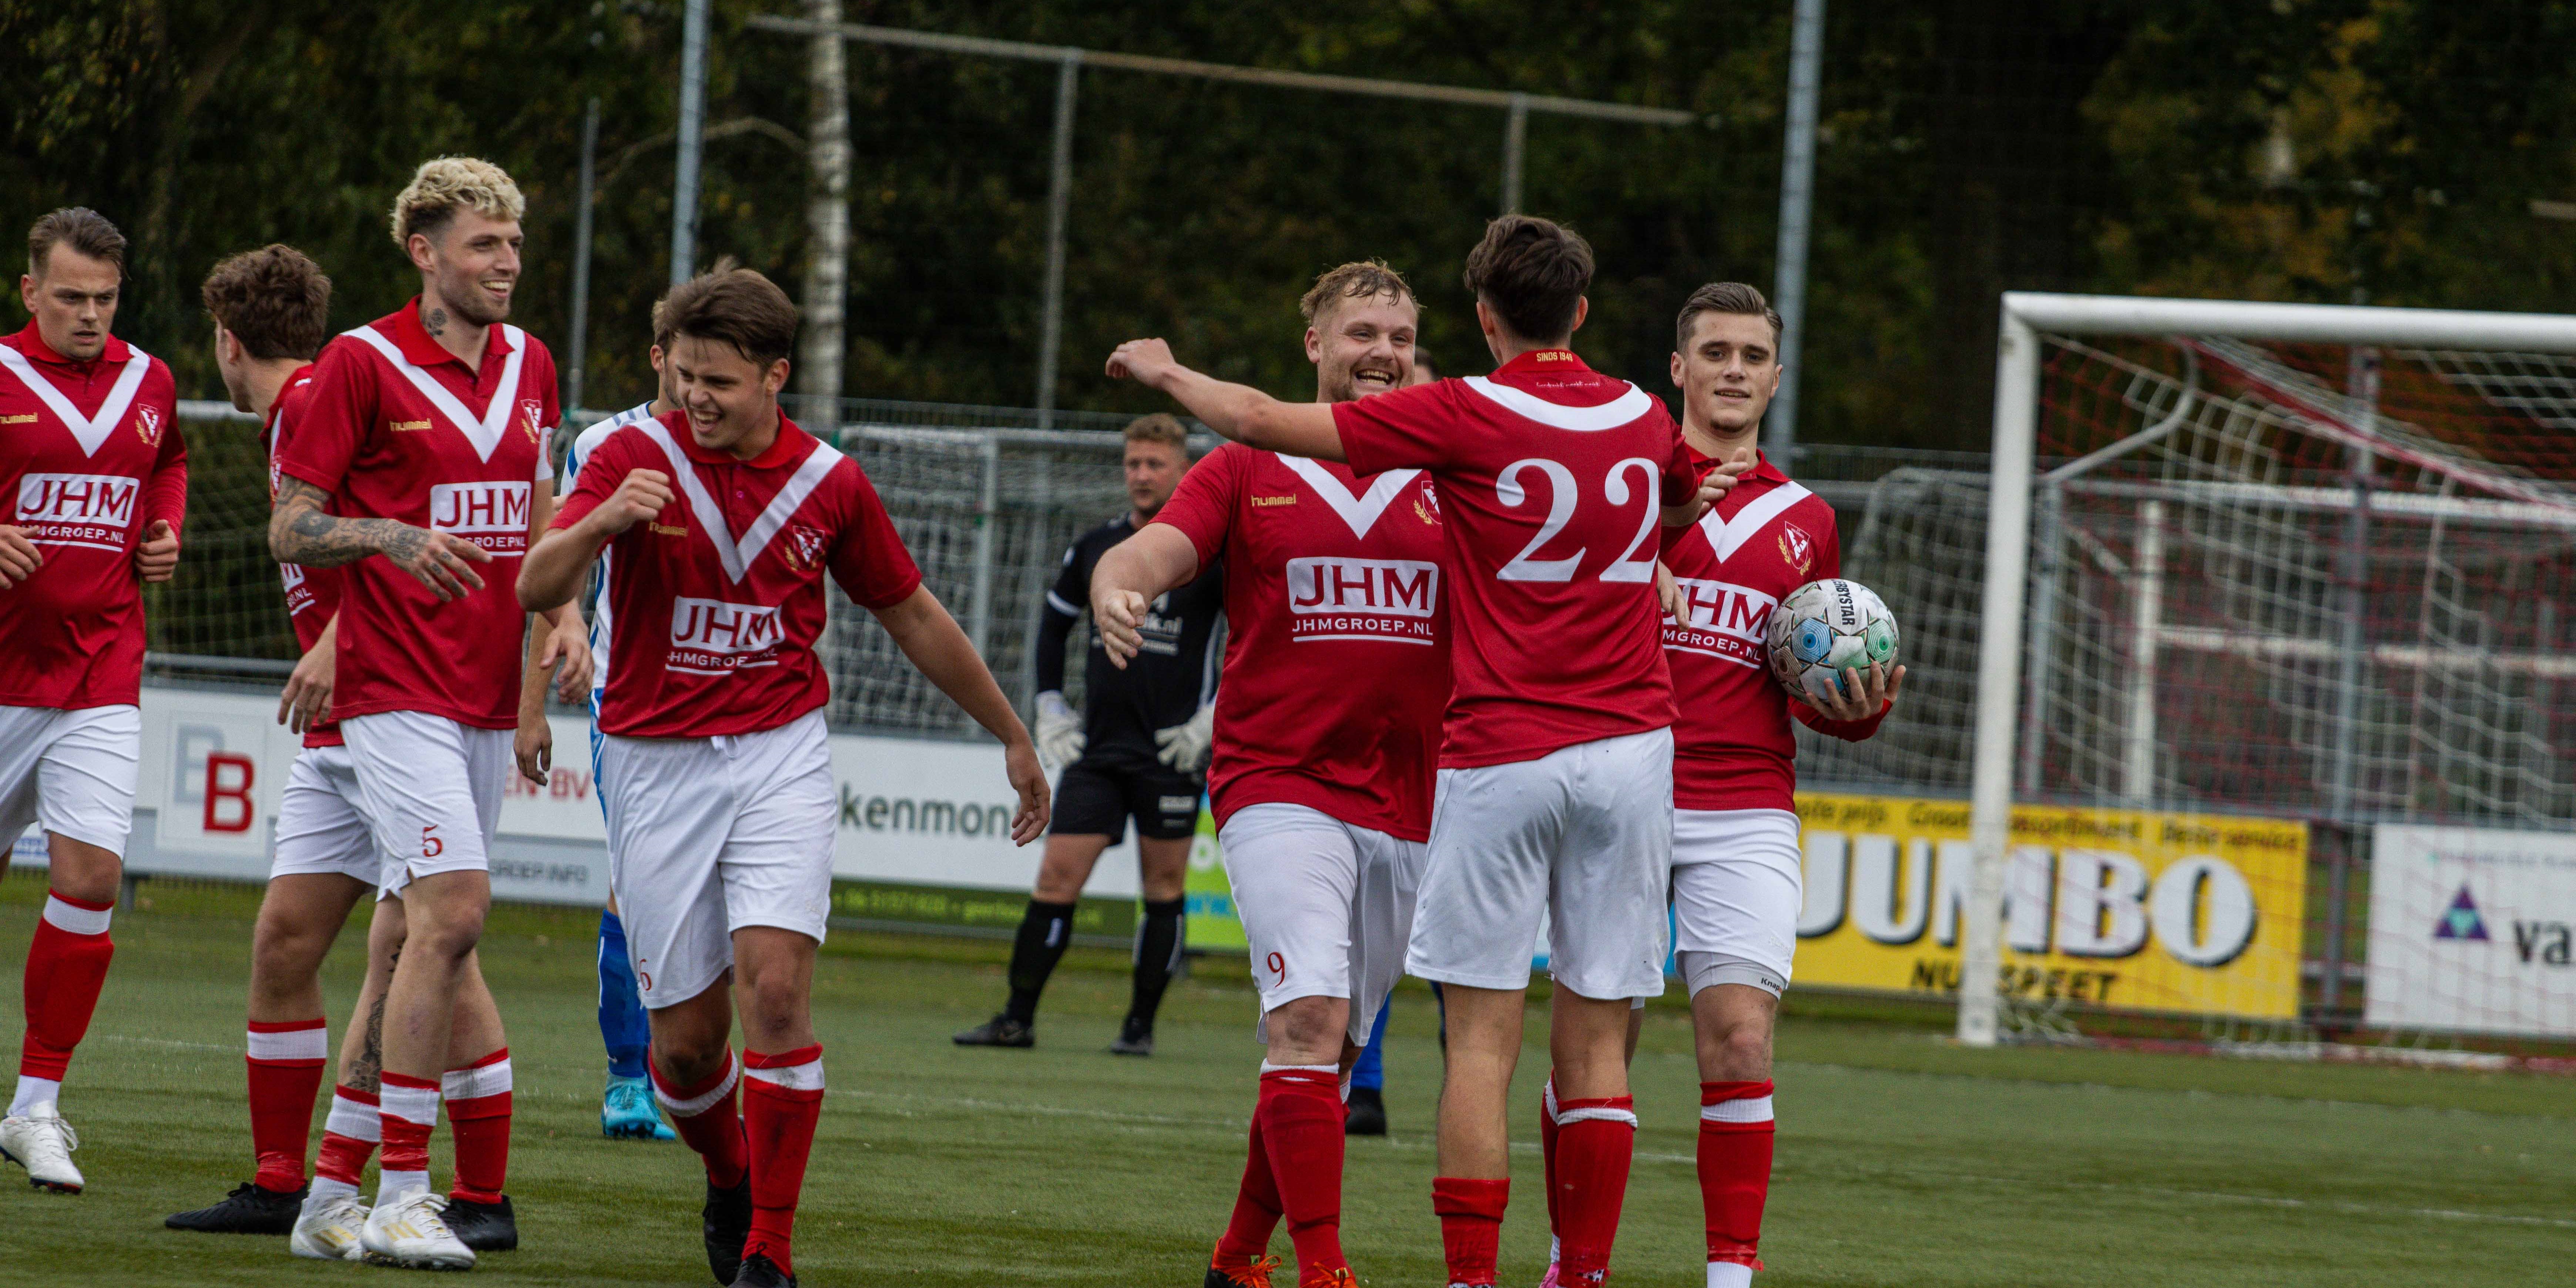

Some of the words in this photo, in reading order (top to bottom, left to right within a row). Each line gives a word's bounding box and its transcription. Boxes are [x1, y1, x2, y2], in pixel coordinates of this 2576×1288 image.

[1536, 352, 1557, 362] SINDS
[1559, 351, 1573, 362] 1949
[389, 417, 432, 431] hummel
[21, 480, 135, 521] JHM
[435, 488, 527, 527] JHM
[1251, 493, 1296, 507] hummel
[1496, 457, 1660, 583] 22
[1294, 565, 1432, 610] JHM
[1831, 579, 1855, 625] ERBYSTAR
[675, 606, 779, 647] JHM
[1292, 618, 1433, 635] JHMGROEP.NL
[204, 752, 253, 832] B
[551, 768, 594, 801] BV
[839, 782, 1020, 837] kenmon
[422, 824, 443, 857] 5
[1797, 830, 2257, 967] JUMBO
[639, 958, 651, 991] 6
[1267, 952, 1285, 988] 9
[1911, 960, 2119, 1000] NUSPEET
